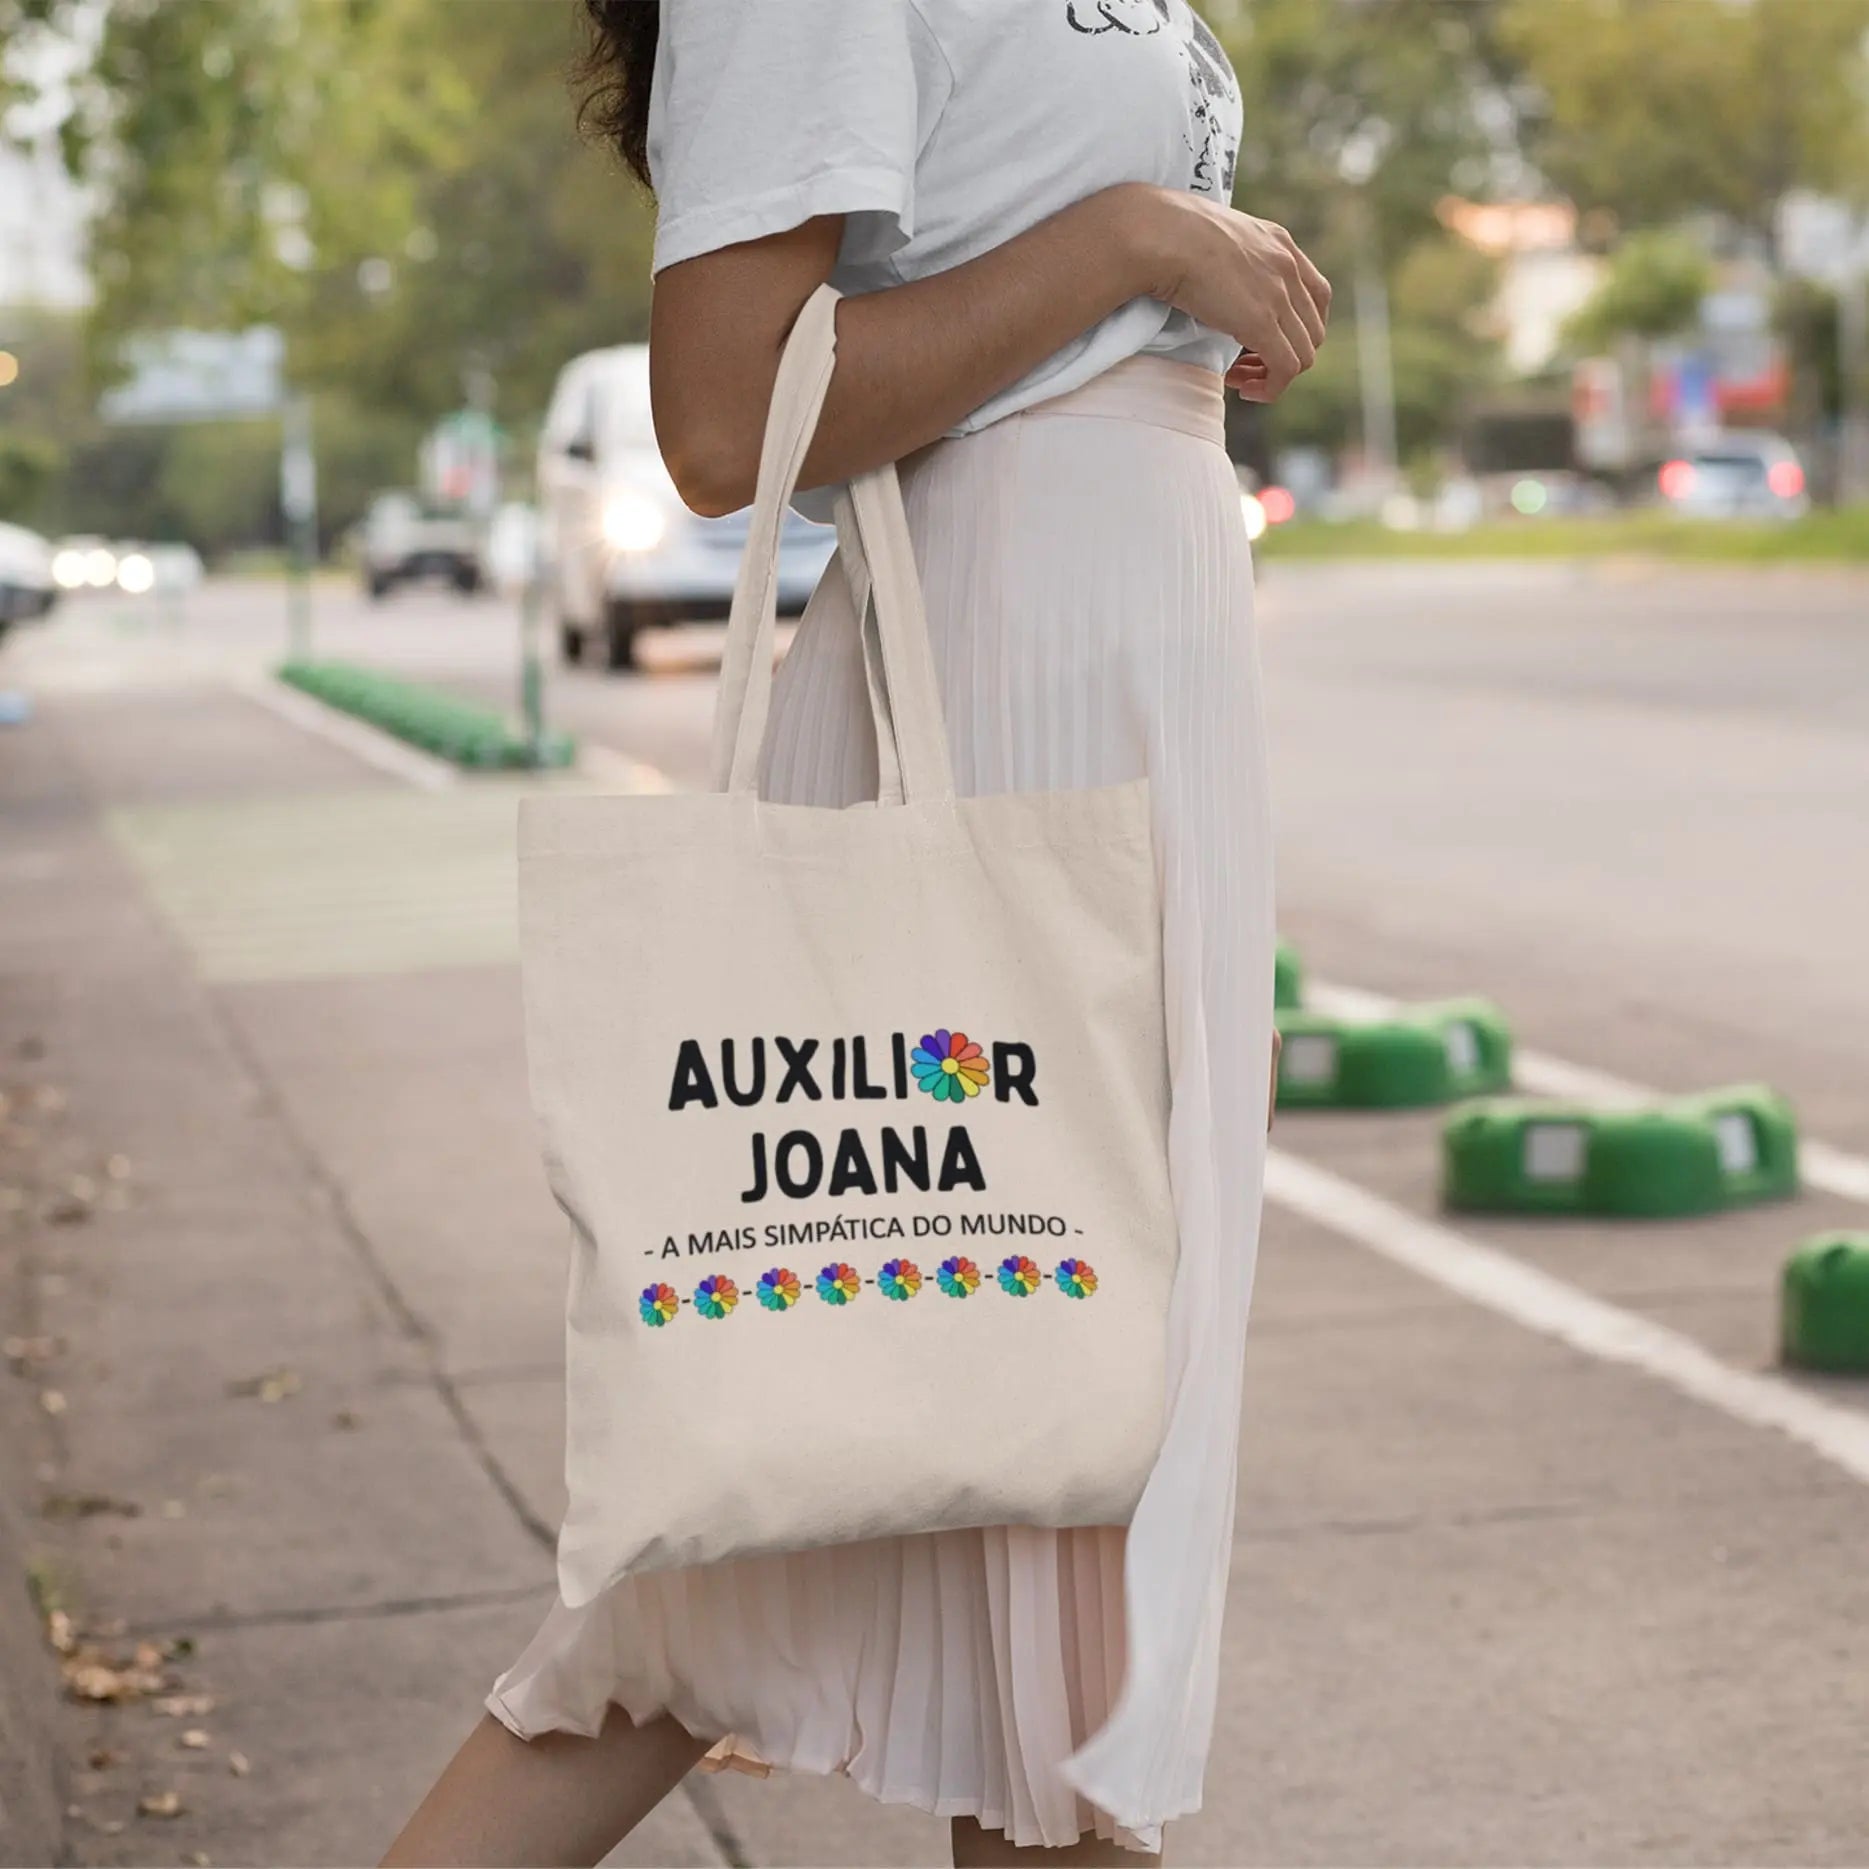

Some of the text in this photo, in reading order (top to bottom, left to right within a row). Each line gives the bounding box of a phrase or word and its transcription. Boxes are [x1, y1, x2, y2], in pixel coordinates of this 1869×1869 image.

[668, 1032, 1039, 1111] AUXILIR
[741, 1126, 987, 1203] JOANA
[661, 1236, 680, 1259] A
[688, 1227, 757, 1255] MAIS
[764, 1214, 905, 1247] SIMPÁTICA
[913, 1216, 952, 1237] DO
[960, 1214, 1067, 1236] MUNDO
